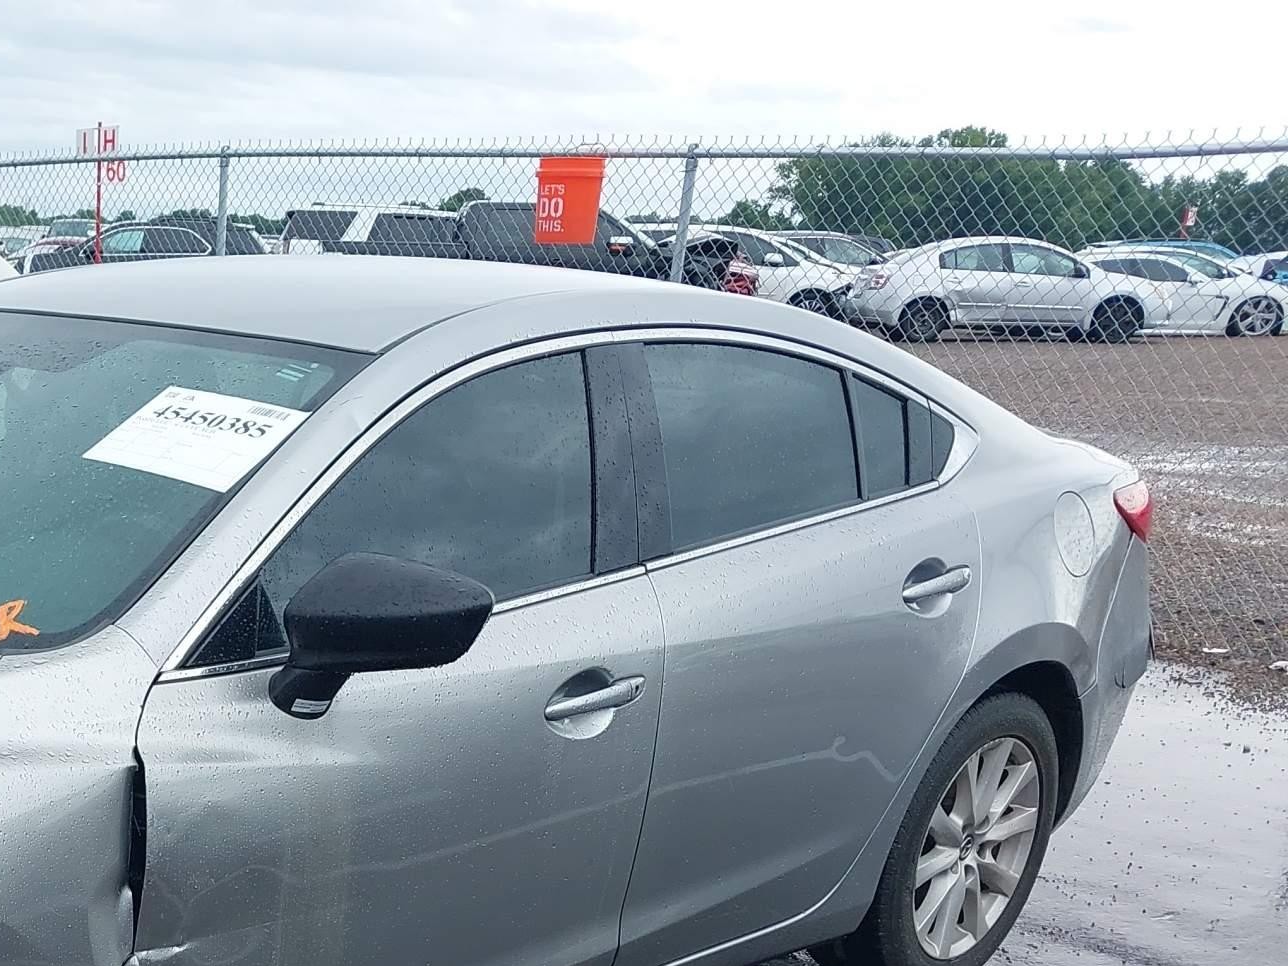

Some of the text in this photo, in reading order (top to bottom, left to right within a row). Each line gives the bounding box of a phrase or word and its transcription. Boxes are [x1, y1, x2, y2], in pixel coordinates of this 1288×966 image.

[103, 129, 116, 152] H
[106, 160, 126, 182] 60
[540, 184, 566, 196] LET'S
[539, 197, 564, 218] DO
[538, 219, 565, 233] THIS.
[153, 404, 273, 439] 45450385
